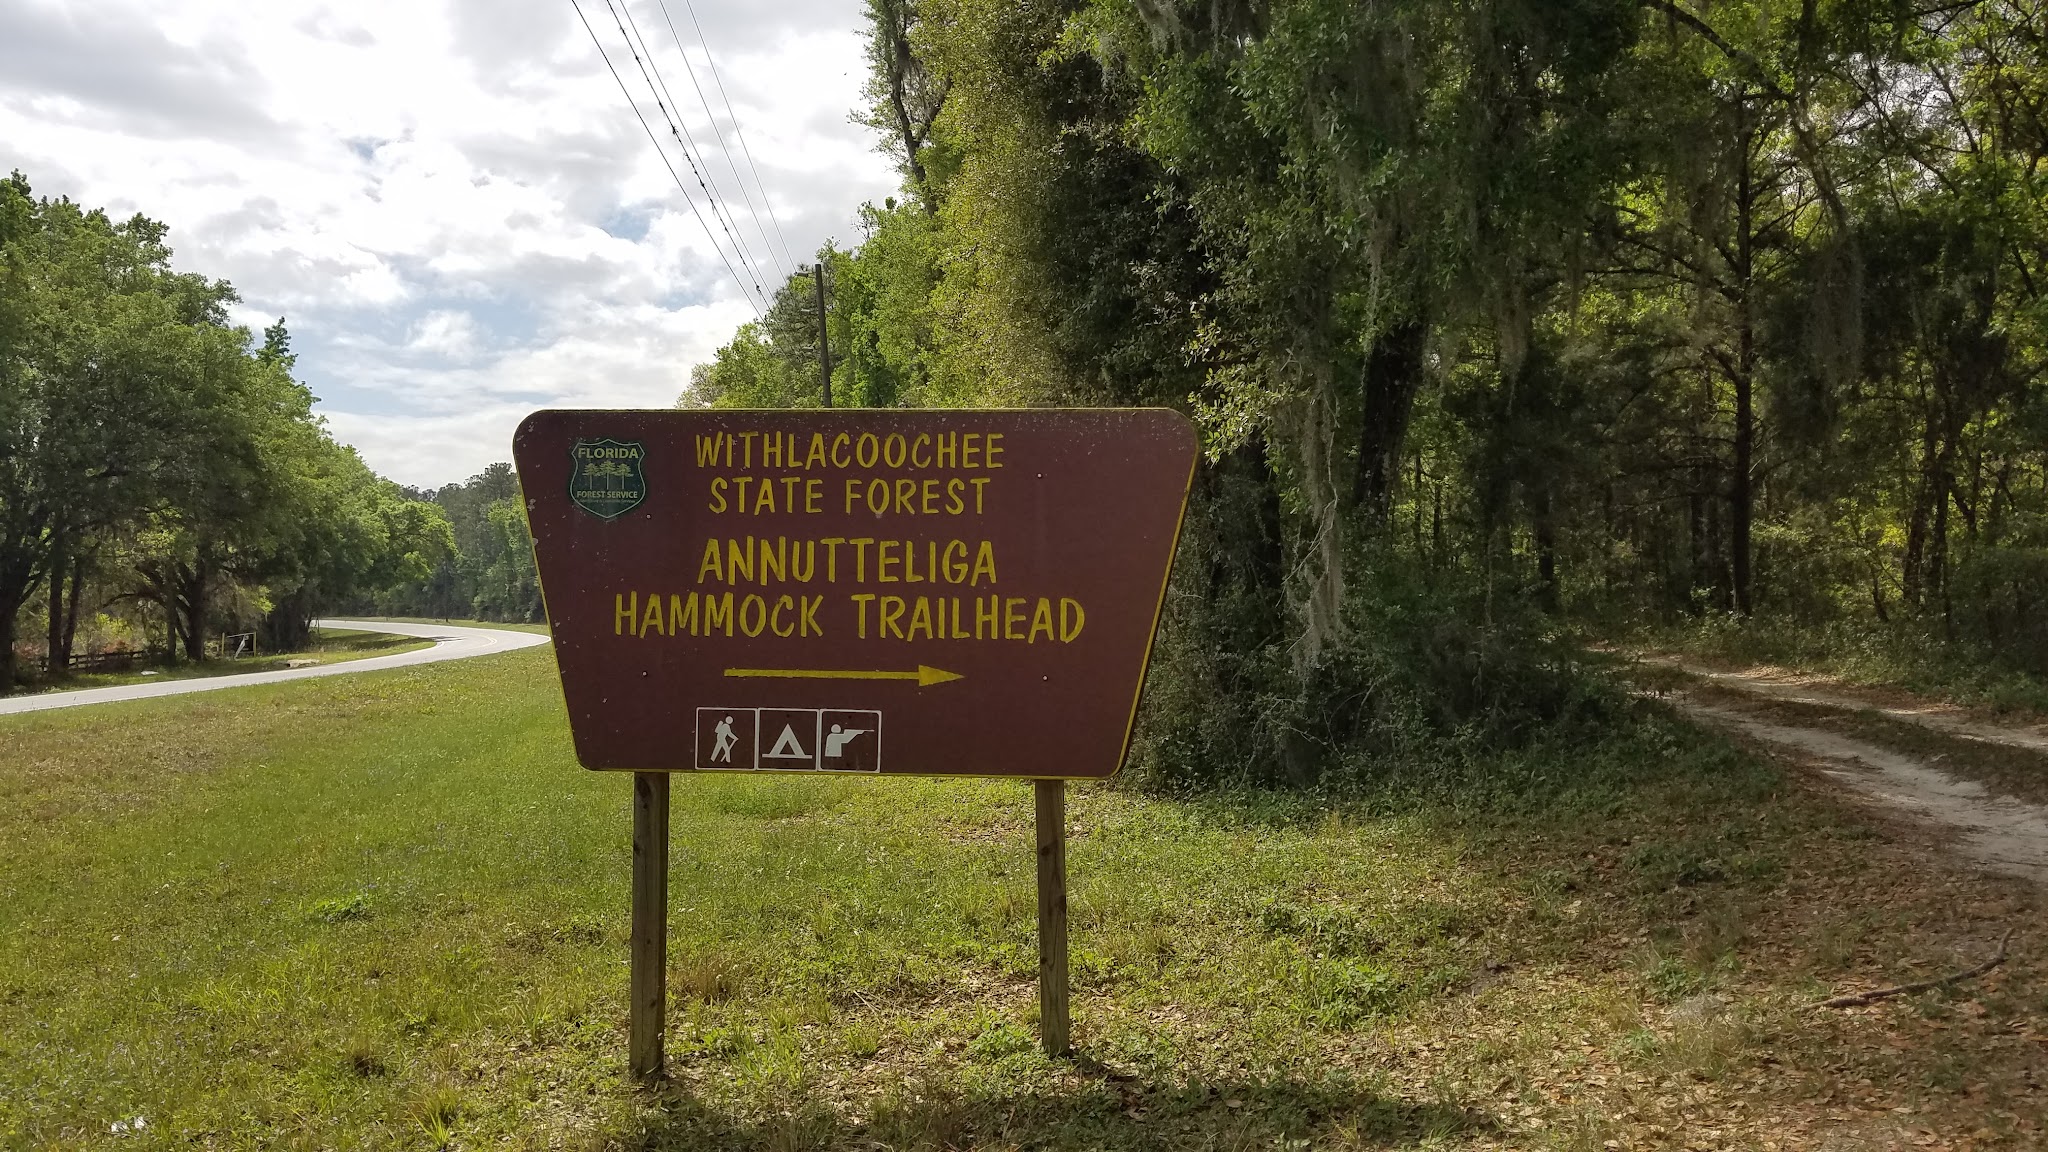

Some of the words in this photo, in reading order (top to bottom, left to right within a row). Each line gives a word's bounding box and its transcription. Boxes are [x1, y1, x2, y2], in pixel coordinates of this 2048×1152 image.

[578, 448, 639, 459] FLORIDA
[695, 431, 1005, 471] WITHLACOOCHEE
[577, 491, 606, 499] FOREST
[607, 491, 638, 499] SERVICE
[708, 476, 824, 515] STATE
[845, 478, 991, 515] FOREST
[697, 535, 997, 587] ANNUTTELIGA
[614, 591, 824, 639] HAMMOCK
[850, 593, 1086, 645] TRAILHEAD
